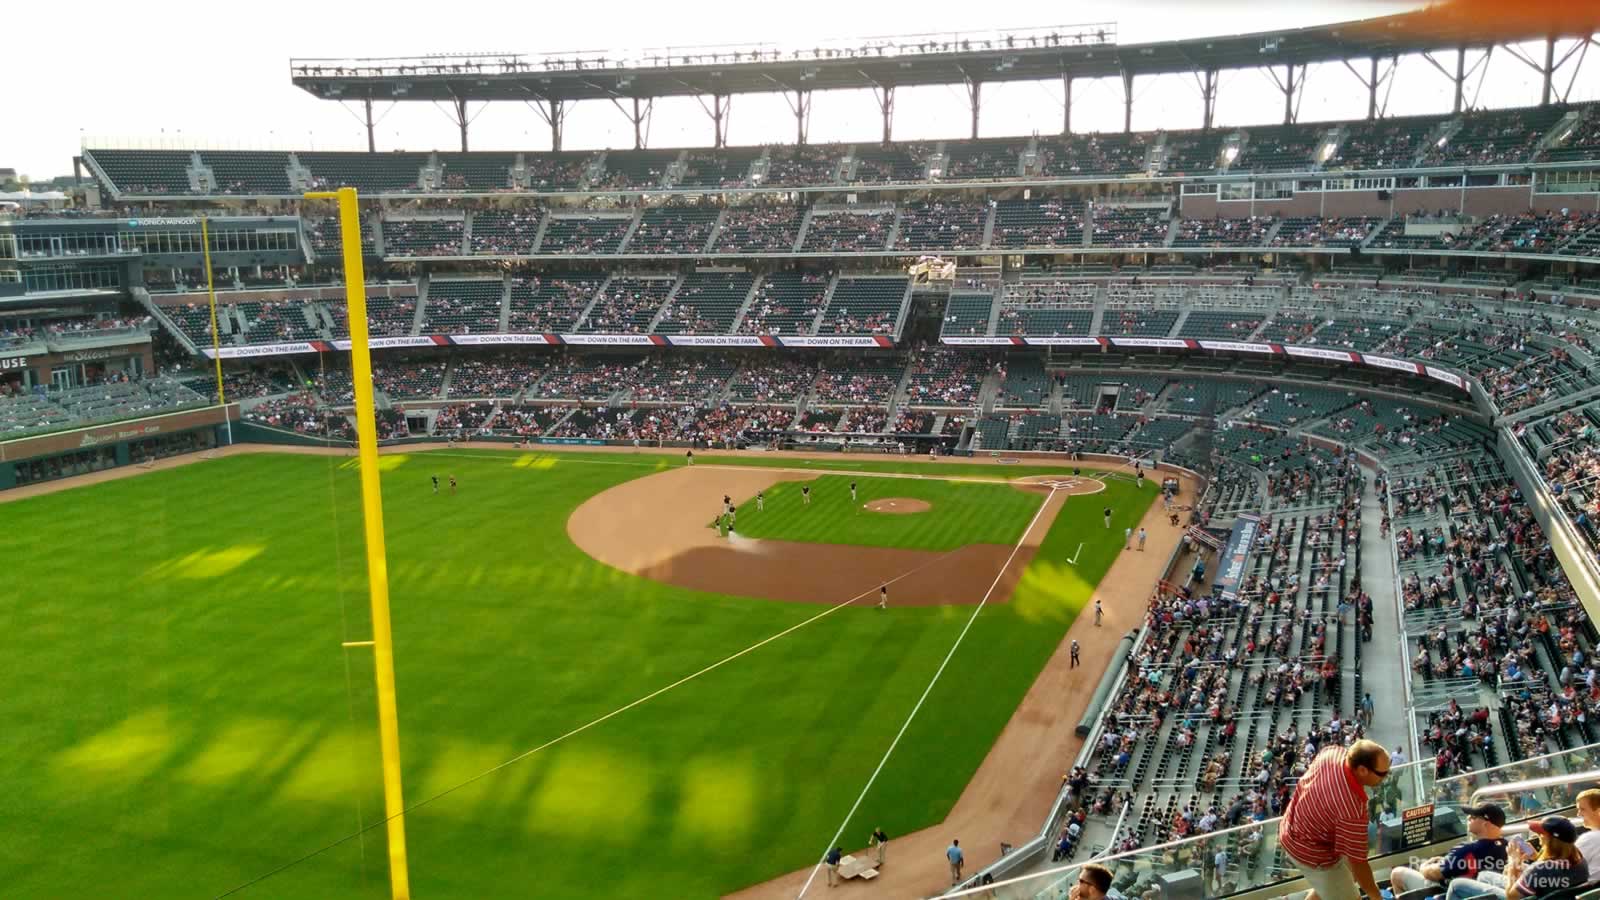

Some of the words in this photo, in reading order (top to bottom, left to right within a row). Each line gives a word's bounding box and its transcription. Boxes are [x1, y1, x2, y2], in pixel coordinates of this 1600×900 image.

[587, 336, 607, 344] DOWN
[807, 337, 828, 345] DOWN
[237, 348, 260, 356] DOWN
[289, 344, 310, 352] FARM
[0, 357, 27, 369] USE
[1406, 806, 1431, 817] CAUTION
